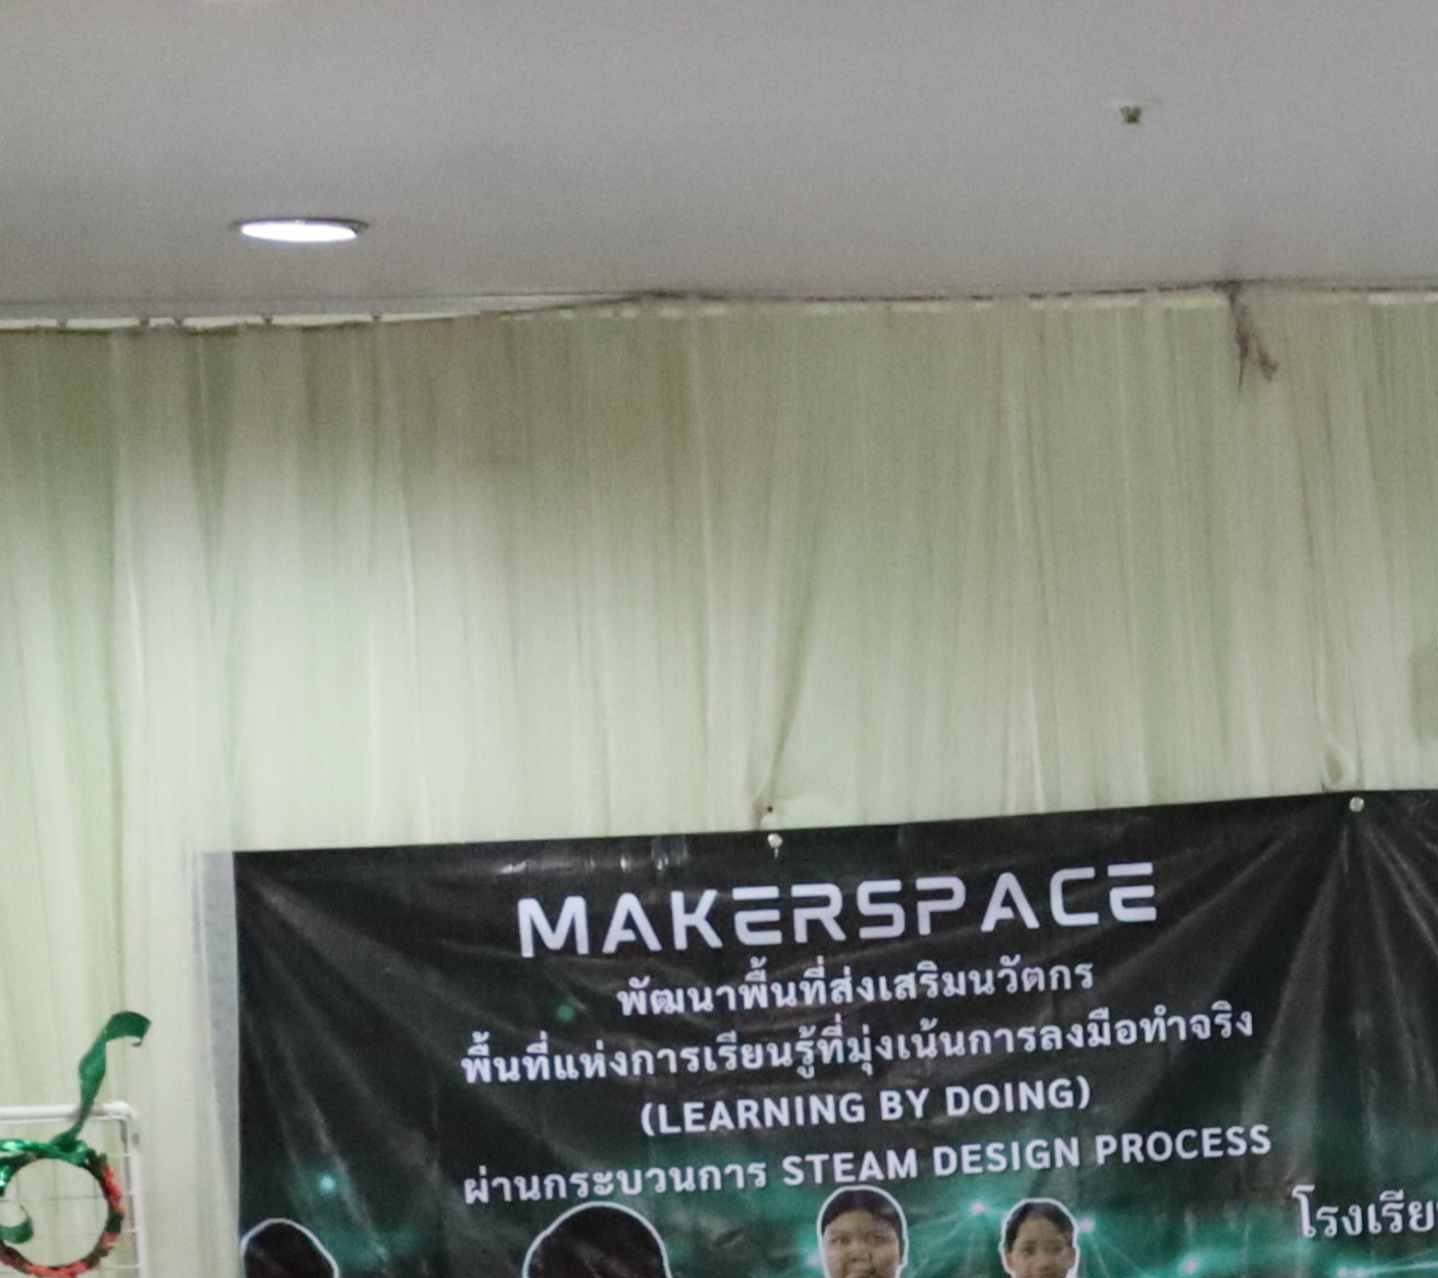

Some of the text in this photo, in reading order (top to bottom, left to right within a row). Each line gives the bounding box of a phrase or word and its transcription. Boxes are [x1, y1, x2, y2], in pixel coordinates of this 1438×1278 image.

[518, 860, 1160, 958] MAKERSPACE
[616, 954, 1095, 1018] พัฒนาพื้นที่ส่งเสริมนวัตกร
[460, 1000, 1255, 1086] พื้นที่แห่งการเรียนรู้ที่มุ่งเน้นการลงมือทำจริง
[640, 1077, 1092, 1138] (LEARNING BY DOING)
[463, 1123, 1273, 1206] ผ่านกระบวนการ STEAM DESIGN PROCESS
